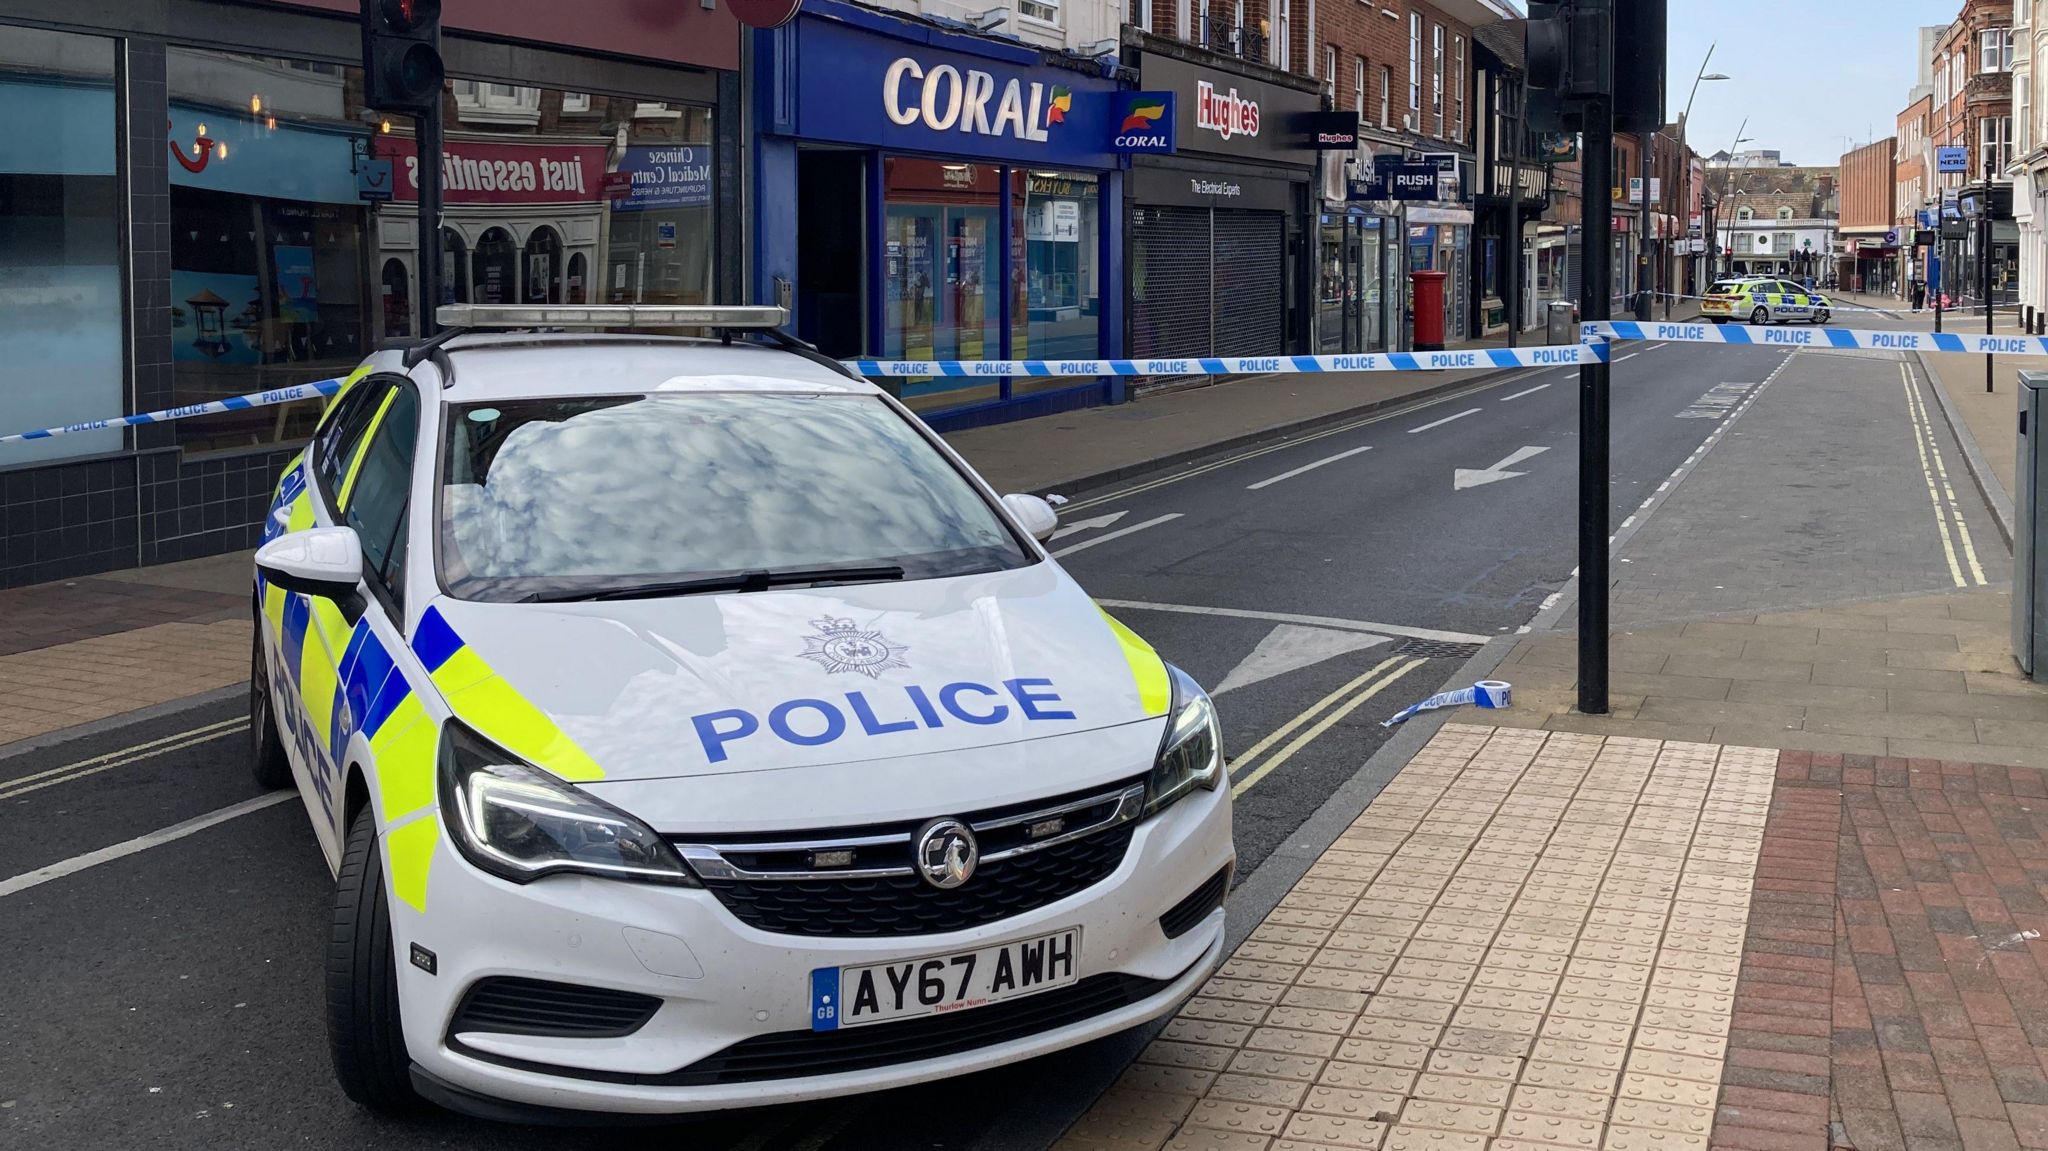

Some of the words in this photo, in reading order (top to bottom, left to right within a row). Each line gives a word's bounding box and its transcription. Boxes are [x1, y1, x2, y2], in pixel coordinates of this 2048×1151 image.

[883, 57, 1049, 142] CORAL
[1198, 82, 1259, 139] Hughes
[1115, 136, 1167, 148] CORAL
[1319, 133, 1353, 143] Hughes
[1356, 158, 1375, 182] RUSH
[1396, 174, 1434, 186] RUSH
[1191, 179, 1200, 193] The
[1202, 180, 1222, 194] Electrical
[1224, 182, 1240, 198] Experts
[1658, 325, 1704, 340] POLICE
[1765, 330, 1811, 344] POLICE
[1872, 334, 1918, 348] POLICE
[1980, 338, 2026, 352] POLICE
[1333, 357, 1375, 369] POLICE
[1431, 354, 1475, 367] POLICE
[1533, 350, 1578, 364] POLICE
[892, 363, 928, 374] POLICE
[976, 363, 1012, 374] POLICE
[1060, 362, 1098, 374] POLICE
[1149, 362, 1188, 373] POLICE
[1239, 360, 1280, 371] POLICE
[262, 388, 304, 404] POLICE
[166, 403, 208, 418] POLICE
[64, 420, 108, 432] POLICE
[690, 678, 1077, 763] POLICE
[273, 642, 336, 836] POLICE
[852, 954, 976, 1016] AY67
[991, 934, 1072, 994] AWH
[934, 1001, 965, 1013] Thurlow
[967, 998, 986, 1008] Nunn
[817, 1006, 834, 1020] GB
